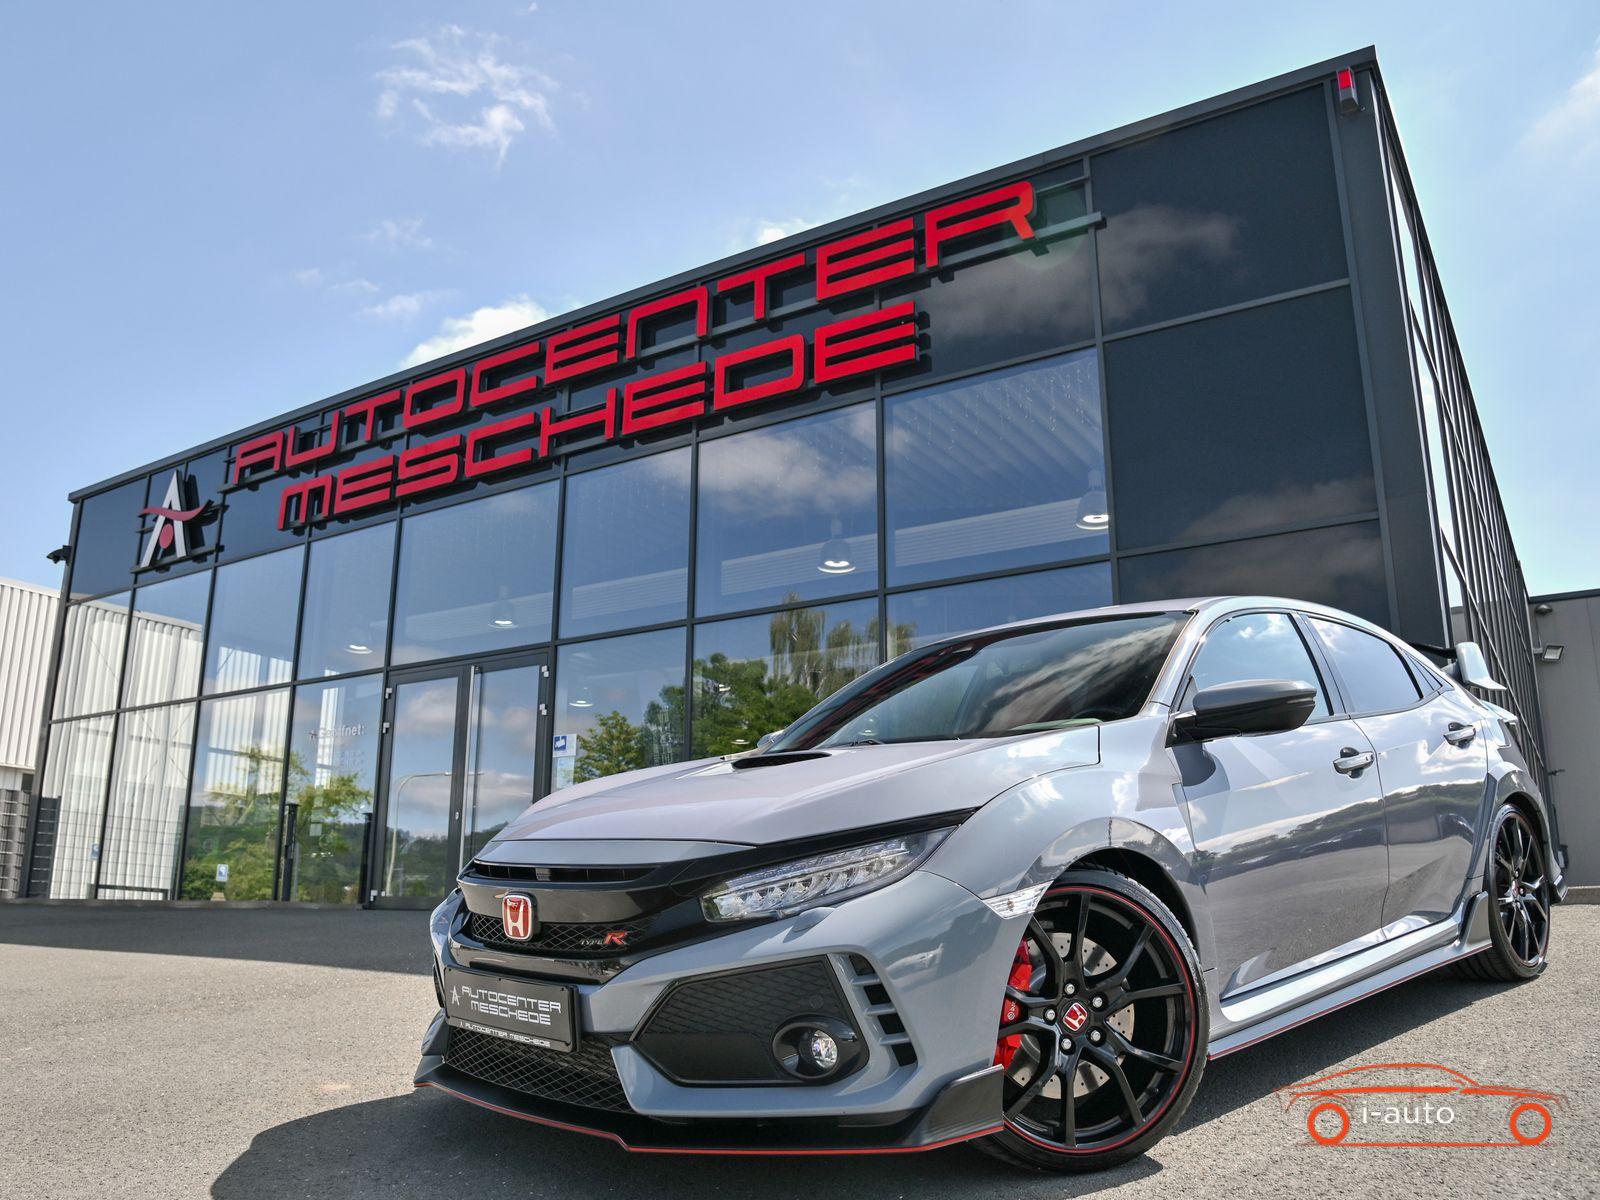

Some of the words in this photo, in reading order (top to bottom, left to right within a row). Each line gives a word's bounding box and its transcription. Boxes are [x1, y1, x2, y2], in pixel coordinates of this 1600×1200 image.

[233, 180, 1036, 485] AUTOCENTER
[278, 300, 919, 530] MESCHEDE
[461, 985, 562, 1014] AUTOCENTER
[470, 1000, 552, 1026] MESCHEDE
